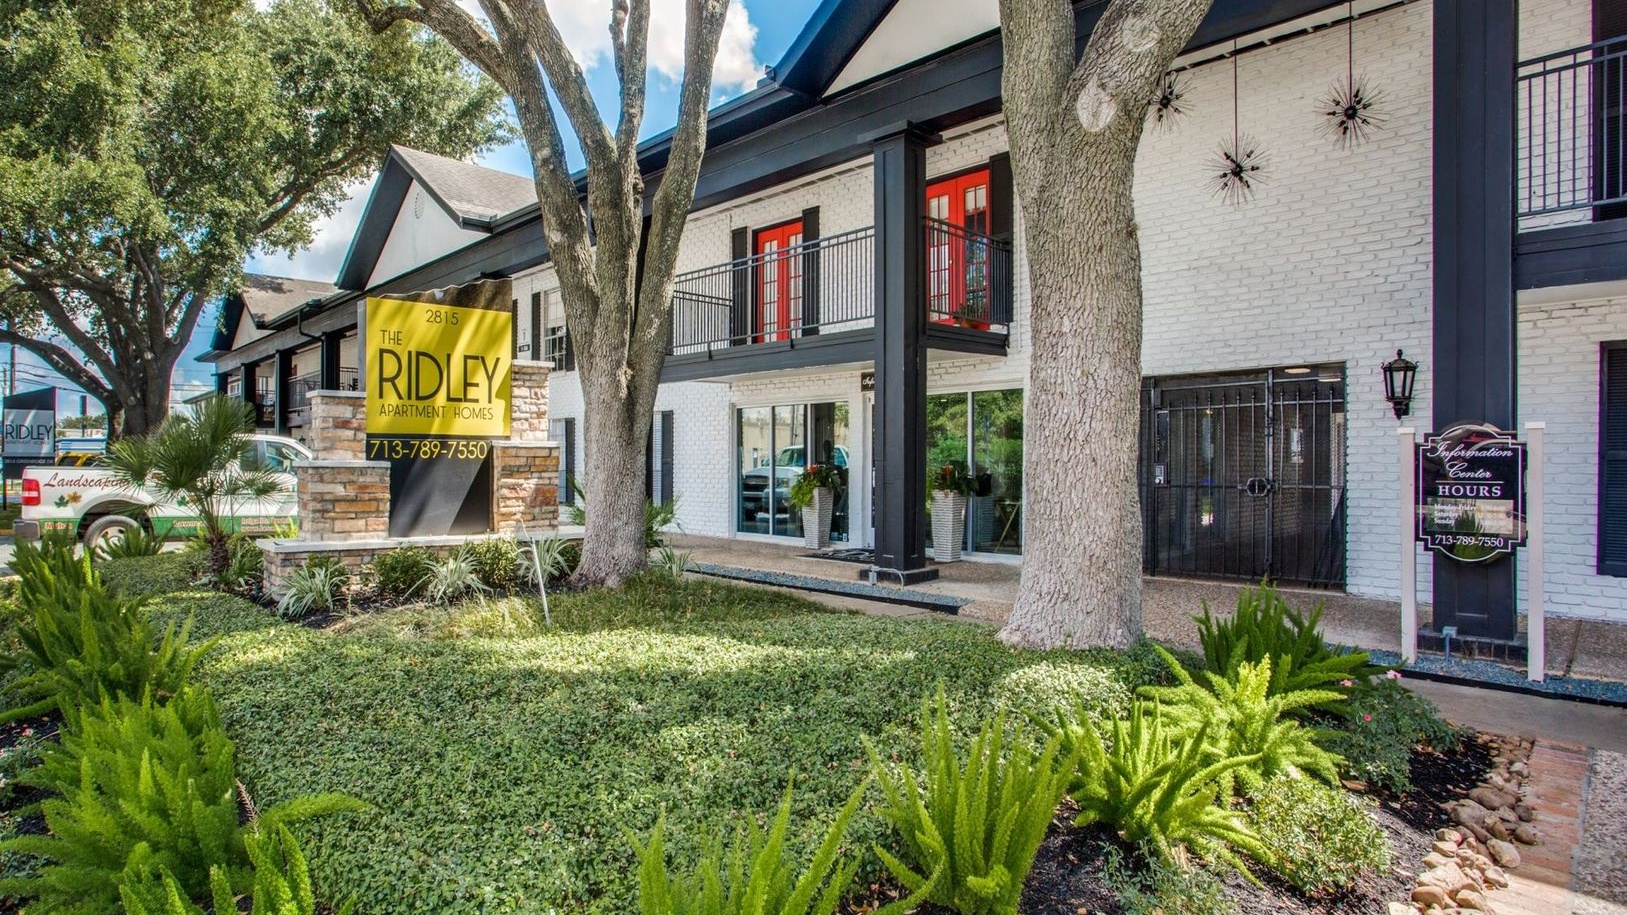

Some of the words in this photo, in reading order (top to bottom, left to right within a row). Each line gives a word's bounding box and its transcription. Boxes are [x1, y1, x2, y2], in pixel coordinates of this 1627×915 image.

[425, 309, 459, 326] 2815
[379, 329, 403, 346] THE
[378, 347, 501, 404] RIDLEY
[379, 403, 447, 419] APARTMENT
[453, 406, 494, 420] HOMES
[5, 424, 53, 441] RIDLEY
[369, 440, 488, 460] 713-789-7550
[1426, 440, 1513, 462] Information
[1446, 461, 1492, 479] Center
[43, 472, 132, 491] Landscaping
[1438, 485, 1502, 497] HOURS
[1435, 534, 1504, 547] 713-789-7550
